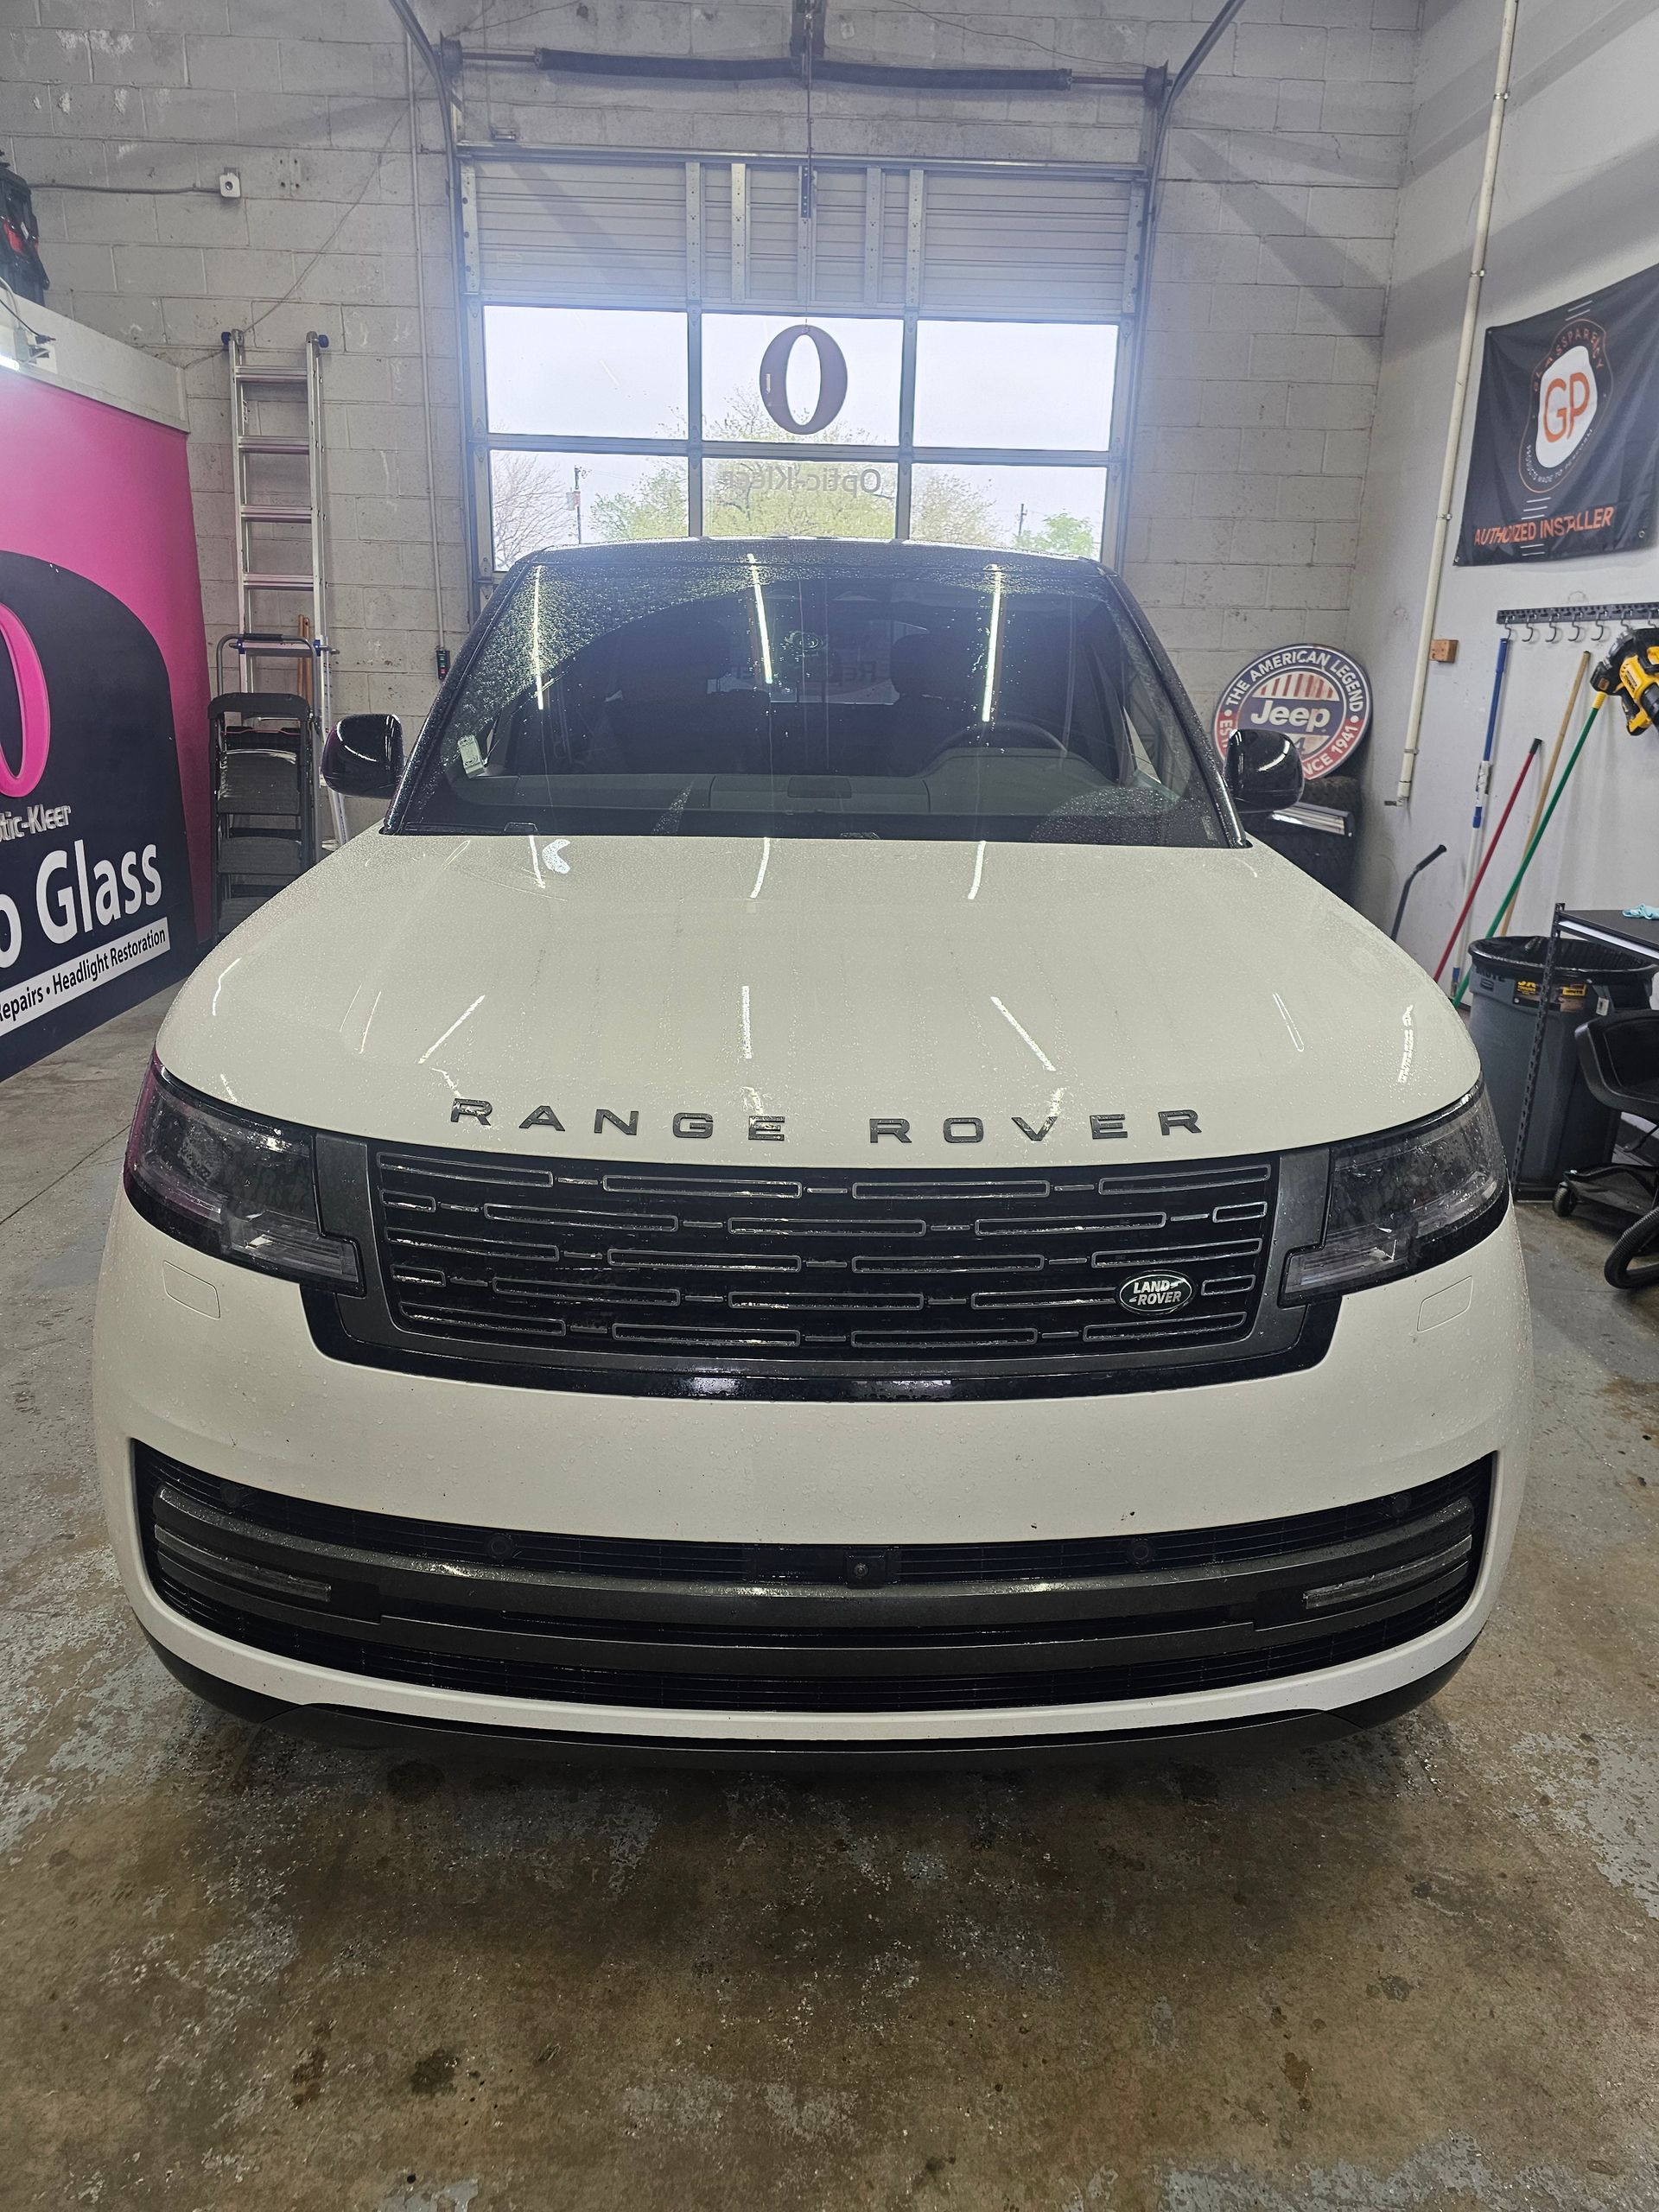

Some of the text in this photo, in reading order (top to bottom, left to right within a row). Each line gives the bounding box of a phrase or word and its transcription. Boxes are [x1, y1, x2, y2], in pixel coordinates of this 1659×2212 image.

[1543, 372, 1590, 442] GP
[1540, 506, 1614, 539] INSTALLER
[1225, 651, 1363, 712] THE AMERICAN LEGEND
[1250, 700, 1331, 733] Jeep
[1302, 726, 1358, 775] NCE 1941
[0, 804, 72, 842] tic-Kleer
[36, 839, 162, 944] Glass
[53, 953, 110, 995] Headlight
[110, 928, 166, 967] Restoration
[450, 1097, 1203, 1144] RANGE ROVER
[1134, 1280, 1170, 1294] LAND
[1137, 1290, 1182, 1306] ROVER
